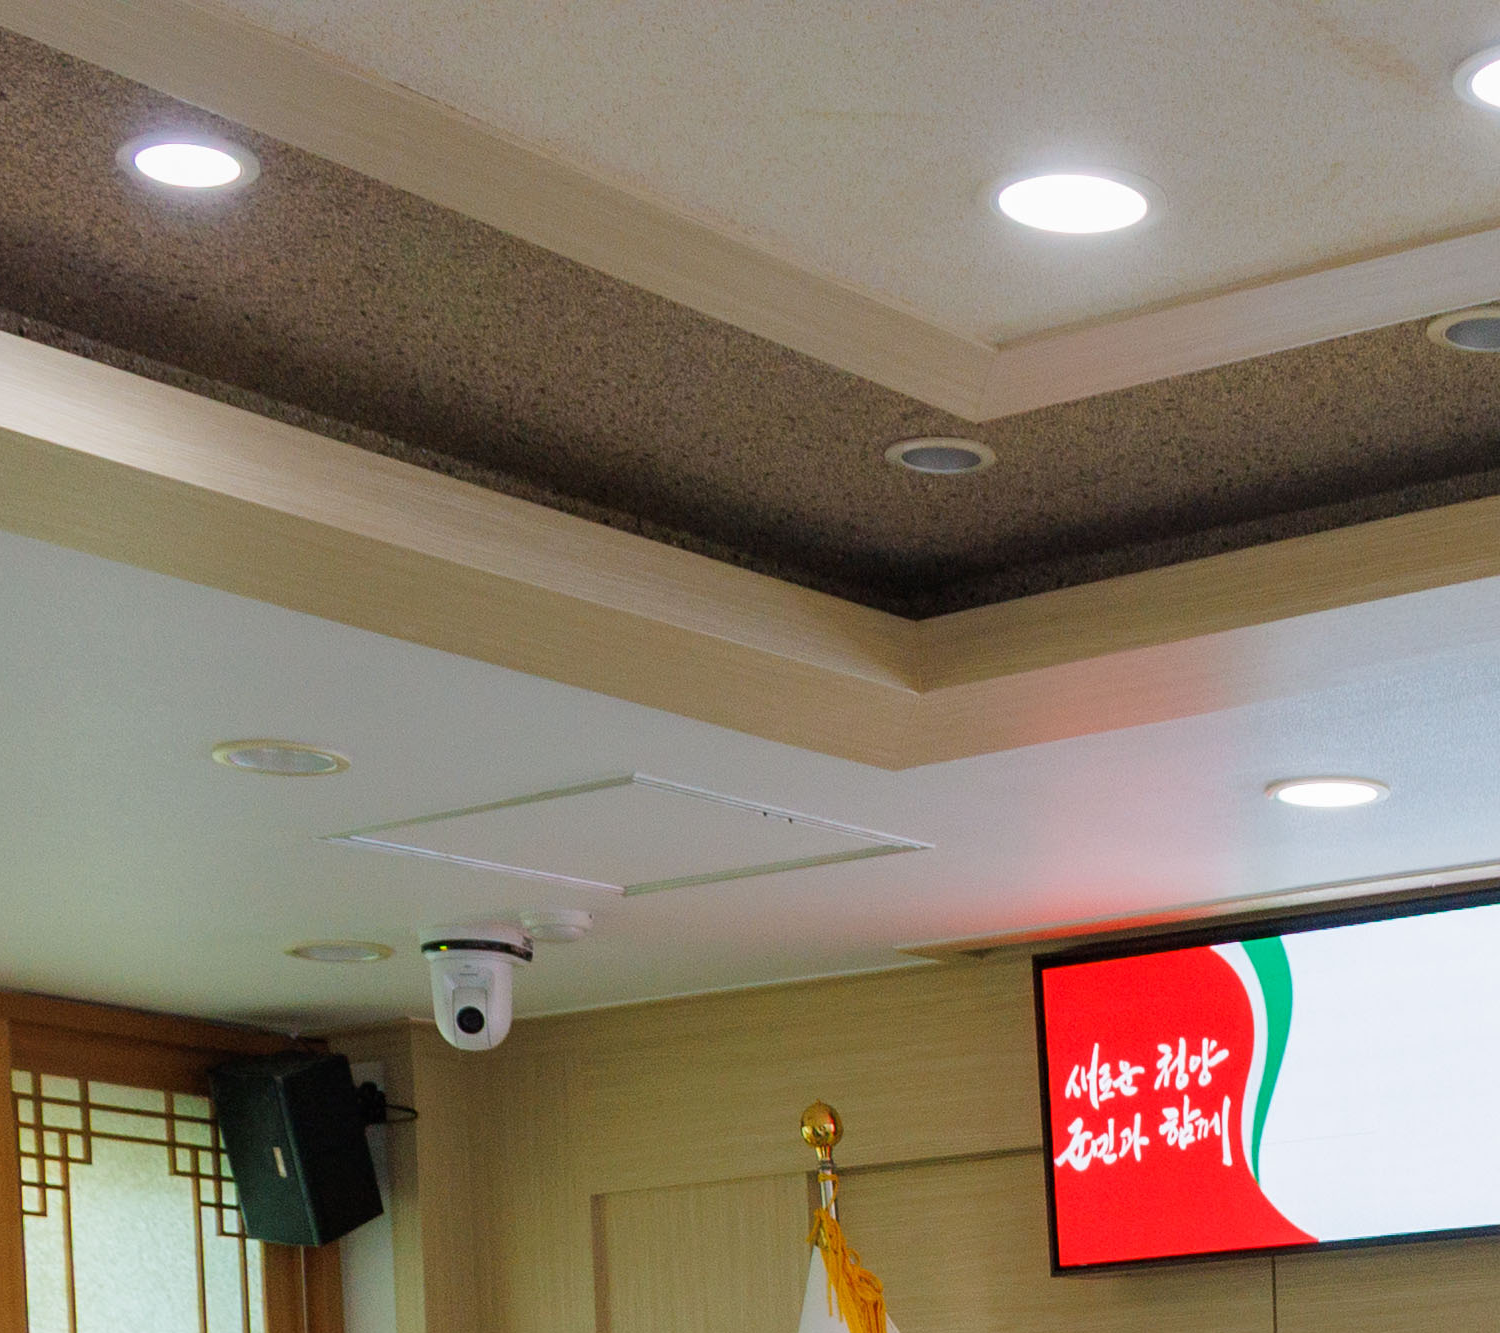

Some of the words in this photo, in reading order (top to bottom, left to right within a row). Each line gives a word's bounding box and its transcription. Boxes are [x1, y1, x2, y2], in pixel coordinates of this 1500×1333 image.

[1065, 1042, 1145, 1110] 새로운
[1154, 1037, 1229, 1090] 청양
[1054, 1112, 1149, 1172] 군민과
[1159, 1094, 1233, 1166] 함께
